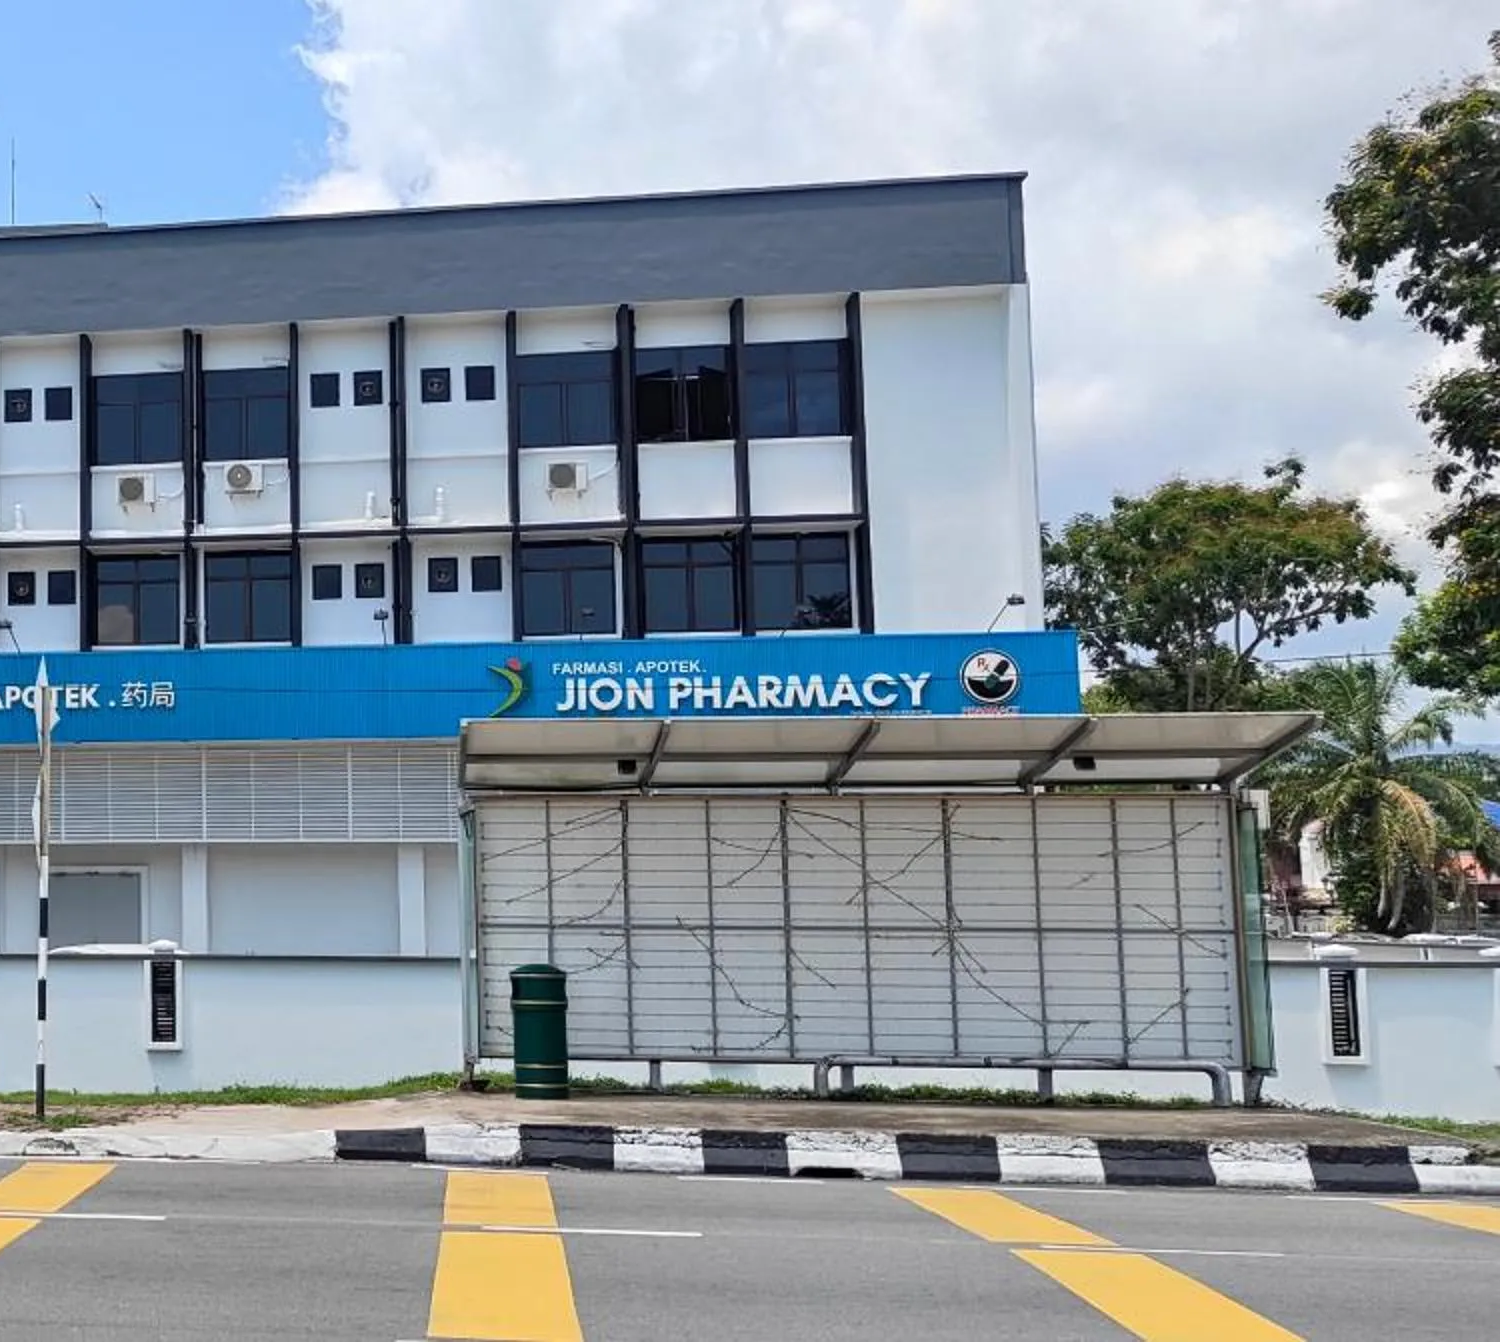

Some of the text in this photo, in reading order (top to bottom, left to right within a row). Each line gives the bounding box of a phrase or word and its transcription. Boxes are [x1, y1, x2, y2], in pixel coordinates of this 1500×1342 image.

[552, 661, 622, 675] FARMASI
[121, 681, 175, 708] 药局
[556, 671, 932, 711] JION PHARMACY
